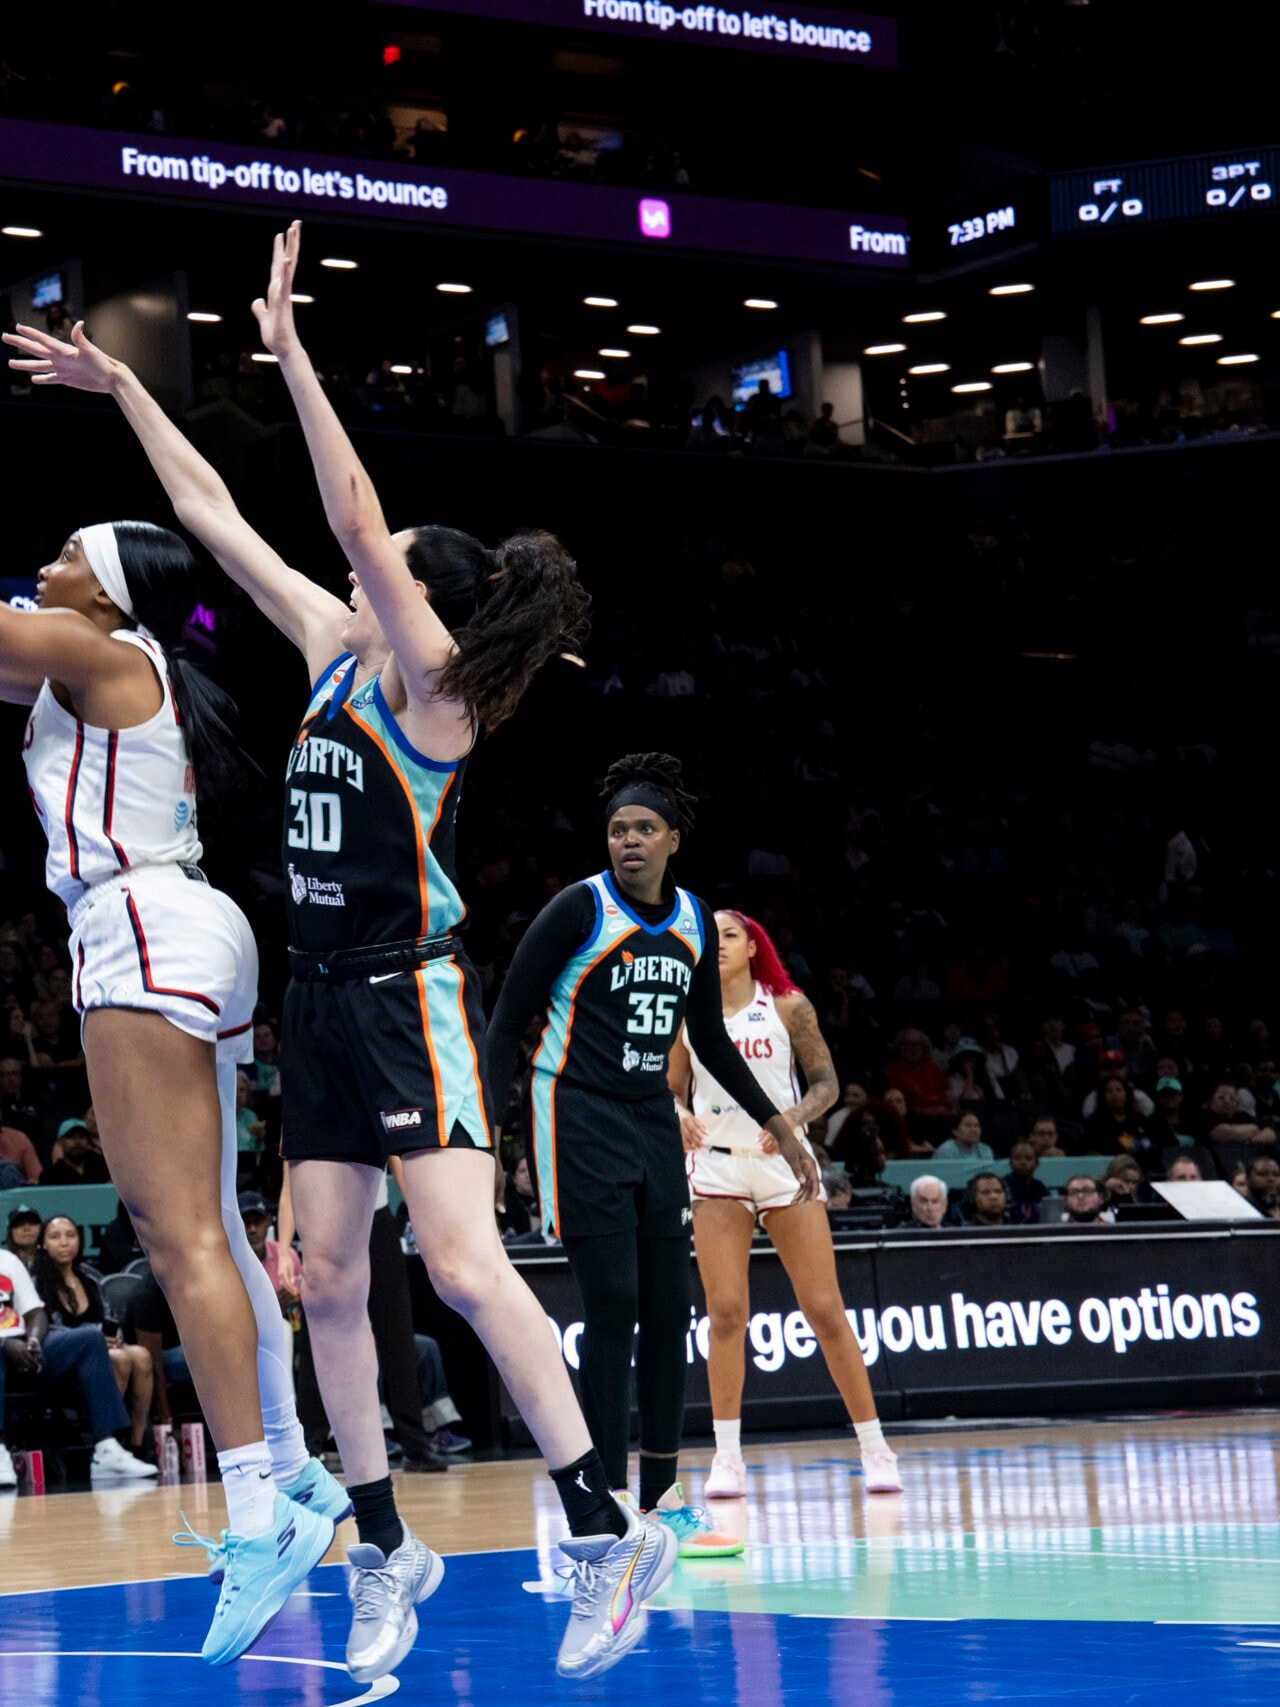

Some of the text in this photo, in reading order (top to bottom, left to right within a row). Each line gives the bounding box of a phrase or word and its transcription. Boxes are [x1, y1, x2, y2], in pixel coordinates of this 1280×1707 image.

[584, 0, 871, 52] From tip-off to let's bounce
[122, 148, 447, 209] From tip-off to let's bounce
[1093, 179, 1122, 195] FT
[1211, 162, 1261, 181] 3PT
[1078, 199, 1143, 223] 0/0
[1206, 184, 1271, 207] 0/0
[850, 225, 907, 255] From
[948, 207, 1014, 245] 7:33 PM
[287, 787, 342, 853] 30
[307, 877, 343, 894] Liberty
[309, 891, 346, 906] Mutual
[610, 955, 692, 996] LIBERTY
[627, 992, 678, 1035] 35
[846, 1305, 946, 1367] you
[952, 1293, 1071, 1349] have
[1079, 1284, 1261, 1353] options
